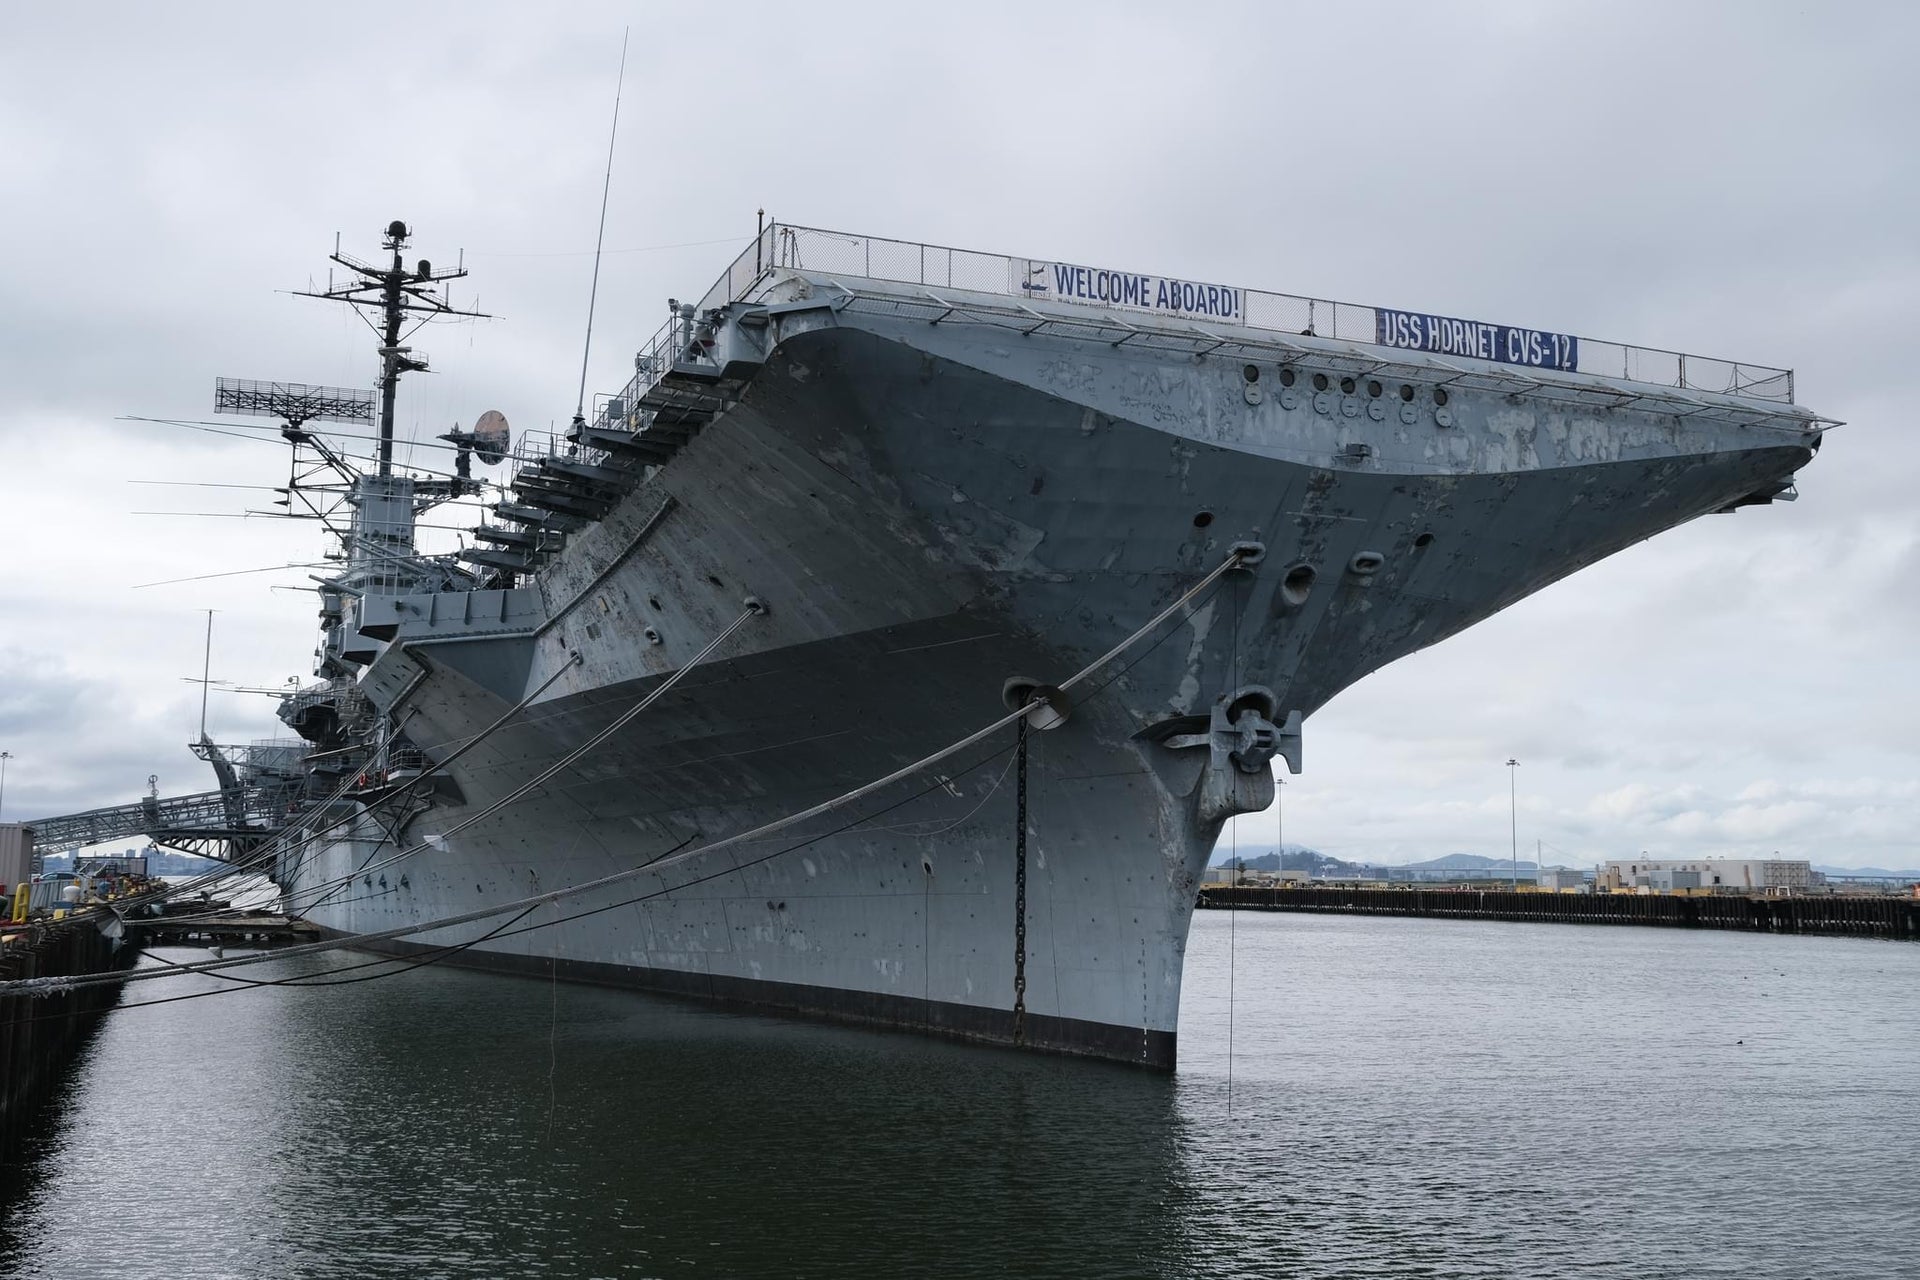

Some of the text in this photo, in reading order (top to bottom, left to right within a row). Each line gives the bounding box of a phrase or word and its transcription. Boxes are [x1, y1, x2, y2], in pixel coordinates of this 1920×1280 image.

[1054, 265, 1239, 318] WELCOME ABOARD!
[1384, 311, 1571, 367] USS HORNET CVS-12
